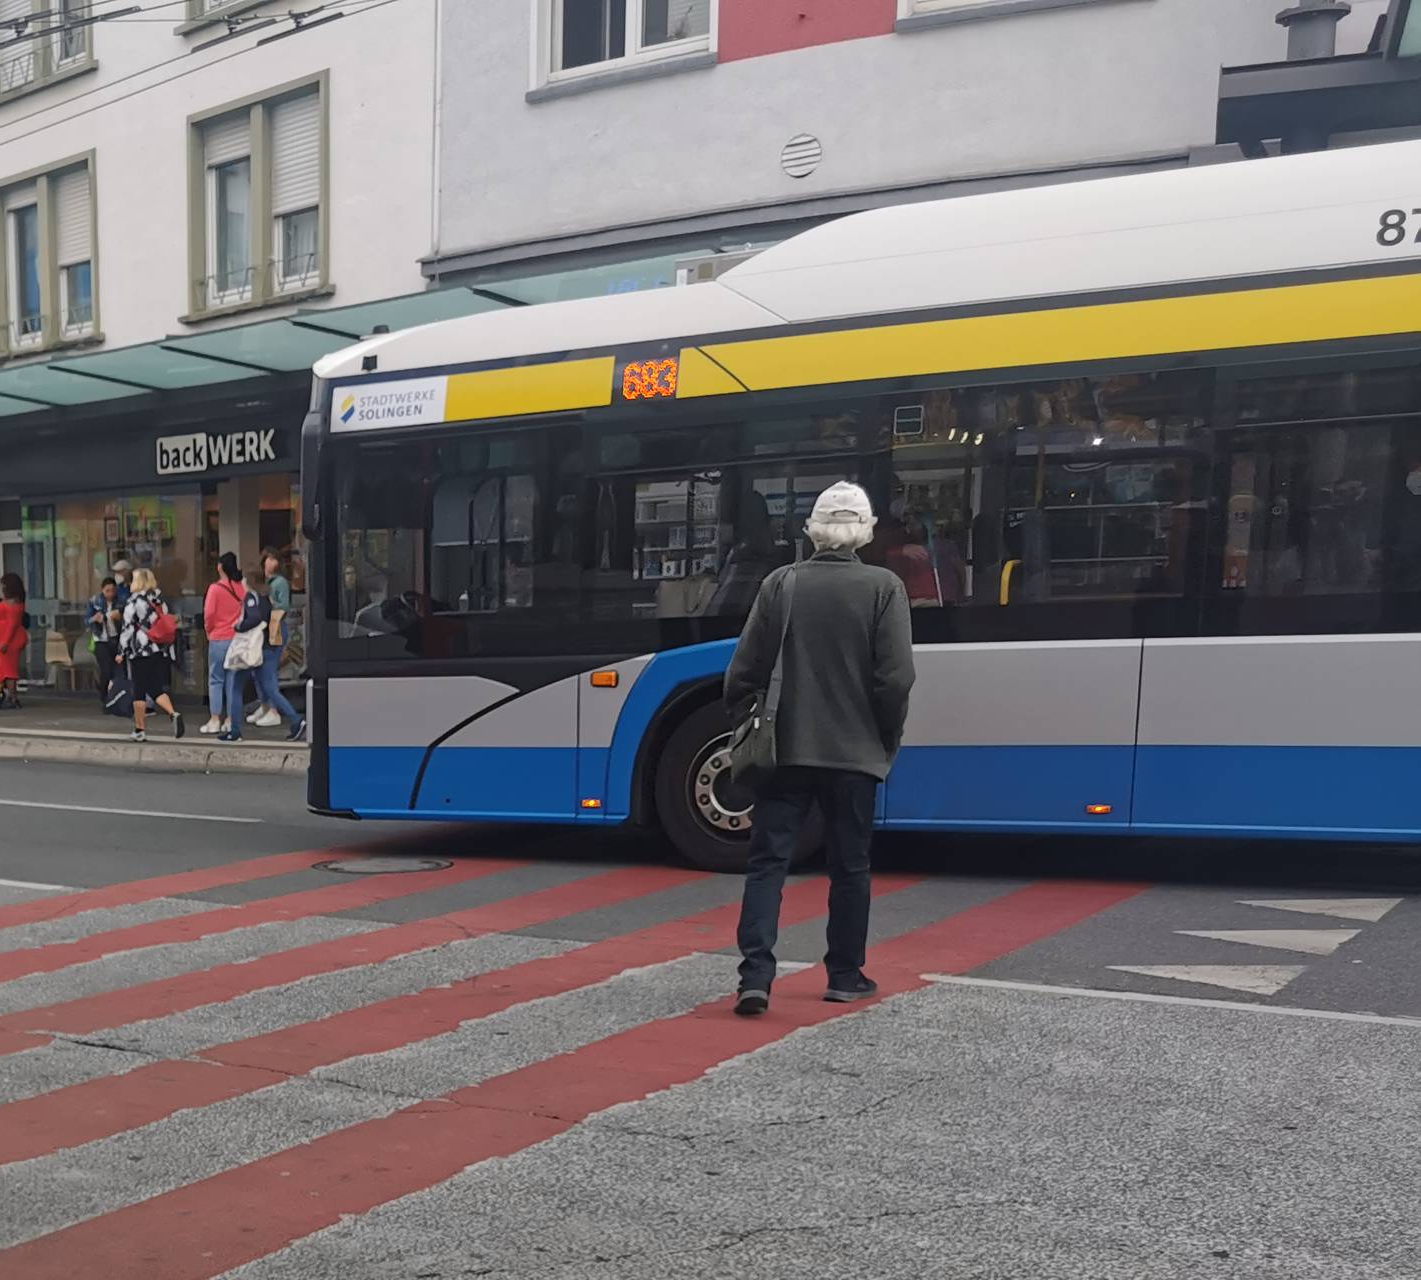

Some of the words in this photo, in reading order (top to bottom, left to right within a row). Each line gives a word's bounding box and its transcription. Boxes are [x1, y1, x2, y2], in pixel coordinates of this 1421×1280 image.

[623, 358, 677, 400] 683
[359, 388, 436, 408] STADTWERKE
[358, 404, 424, 421] SOLINGEN
